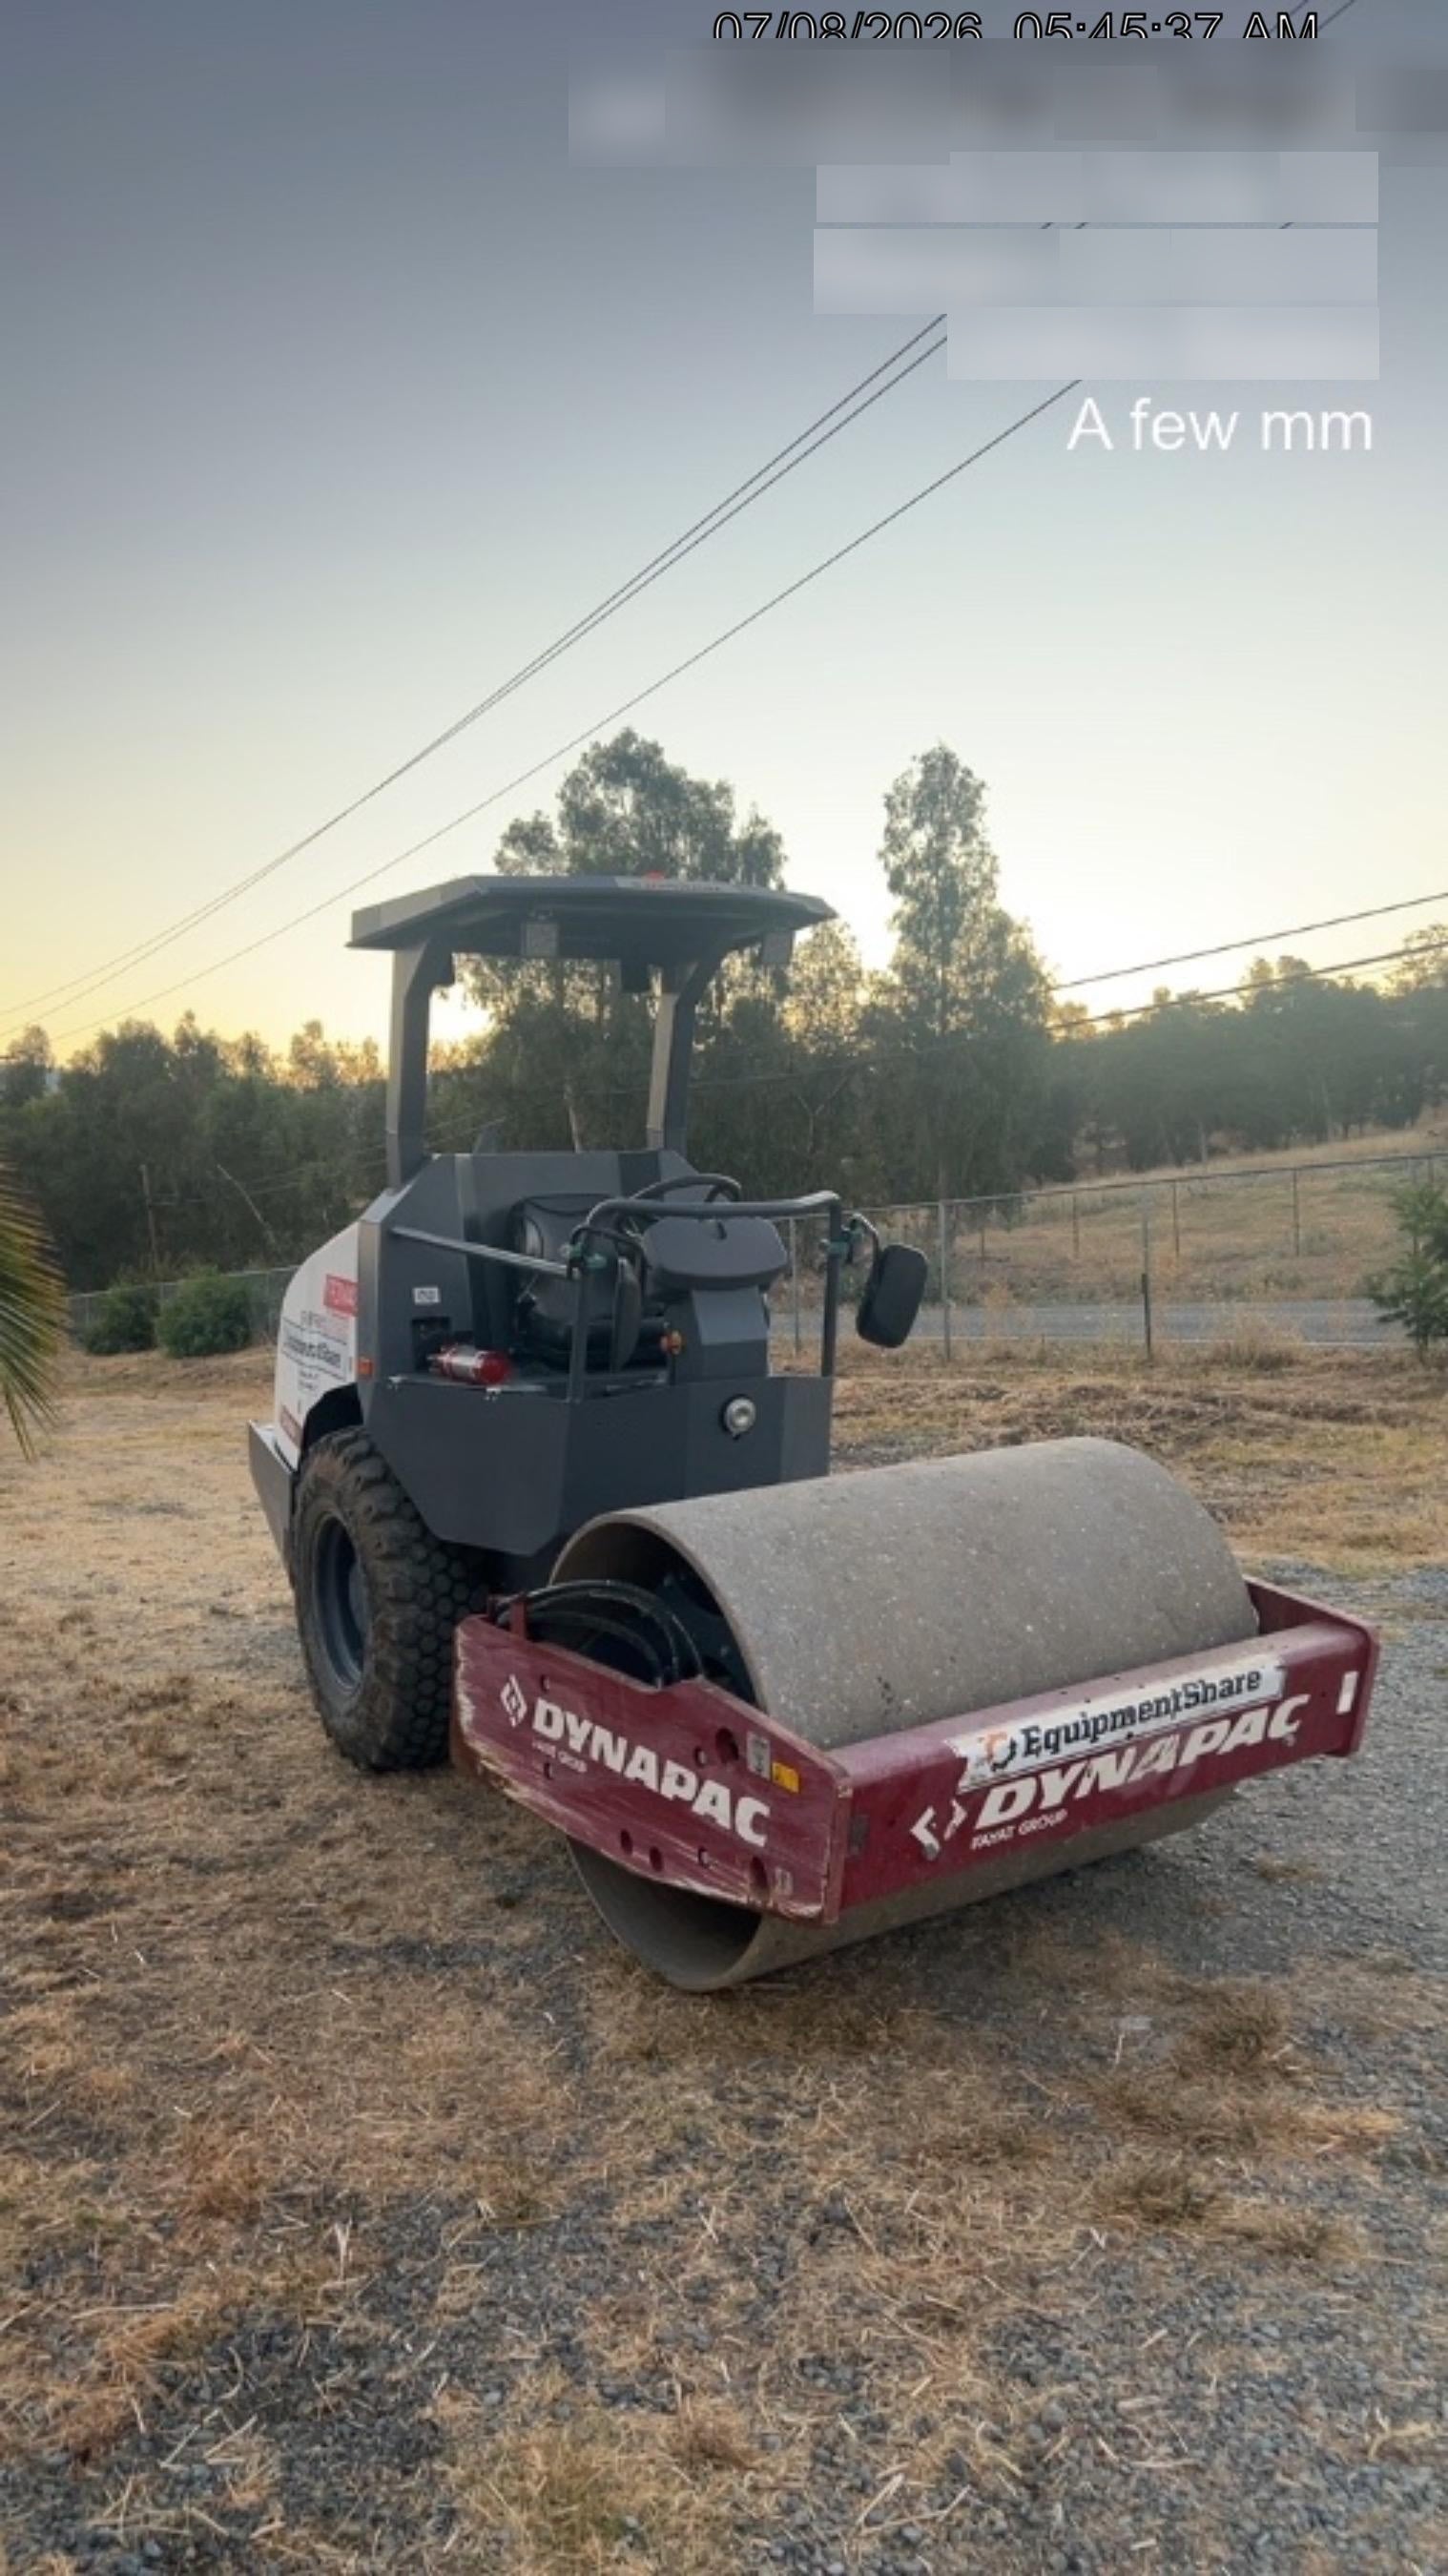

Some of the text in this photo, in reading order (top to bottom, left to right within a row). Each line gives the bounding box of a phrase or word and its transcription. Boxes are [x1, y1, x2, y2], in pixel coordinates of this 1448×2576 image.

[531, 1697, 771, 1847] DYNAPAC
[975, 1693, 1311, 1830] DYNAPAC
[1021, 1670, 1262, 1758] EquipmentShare
